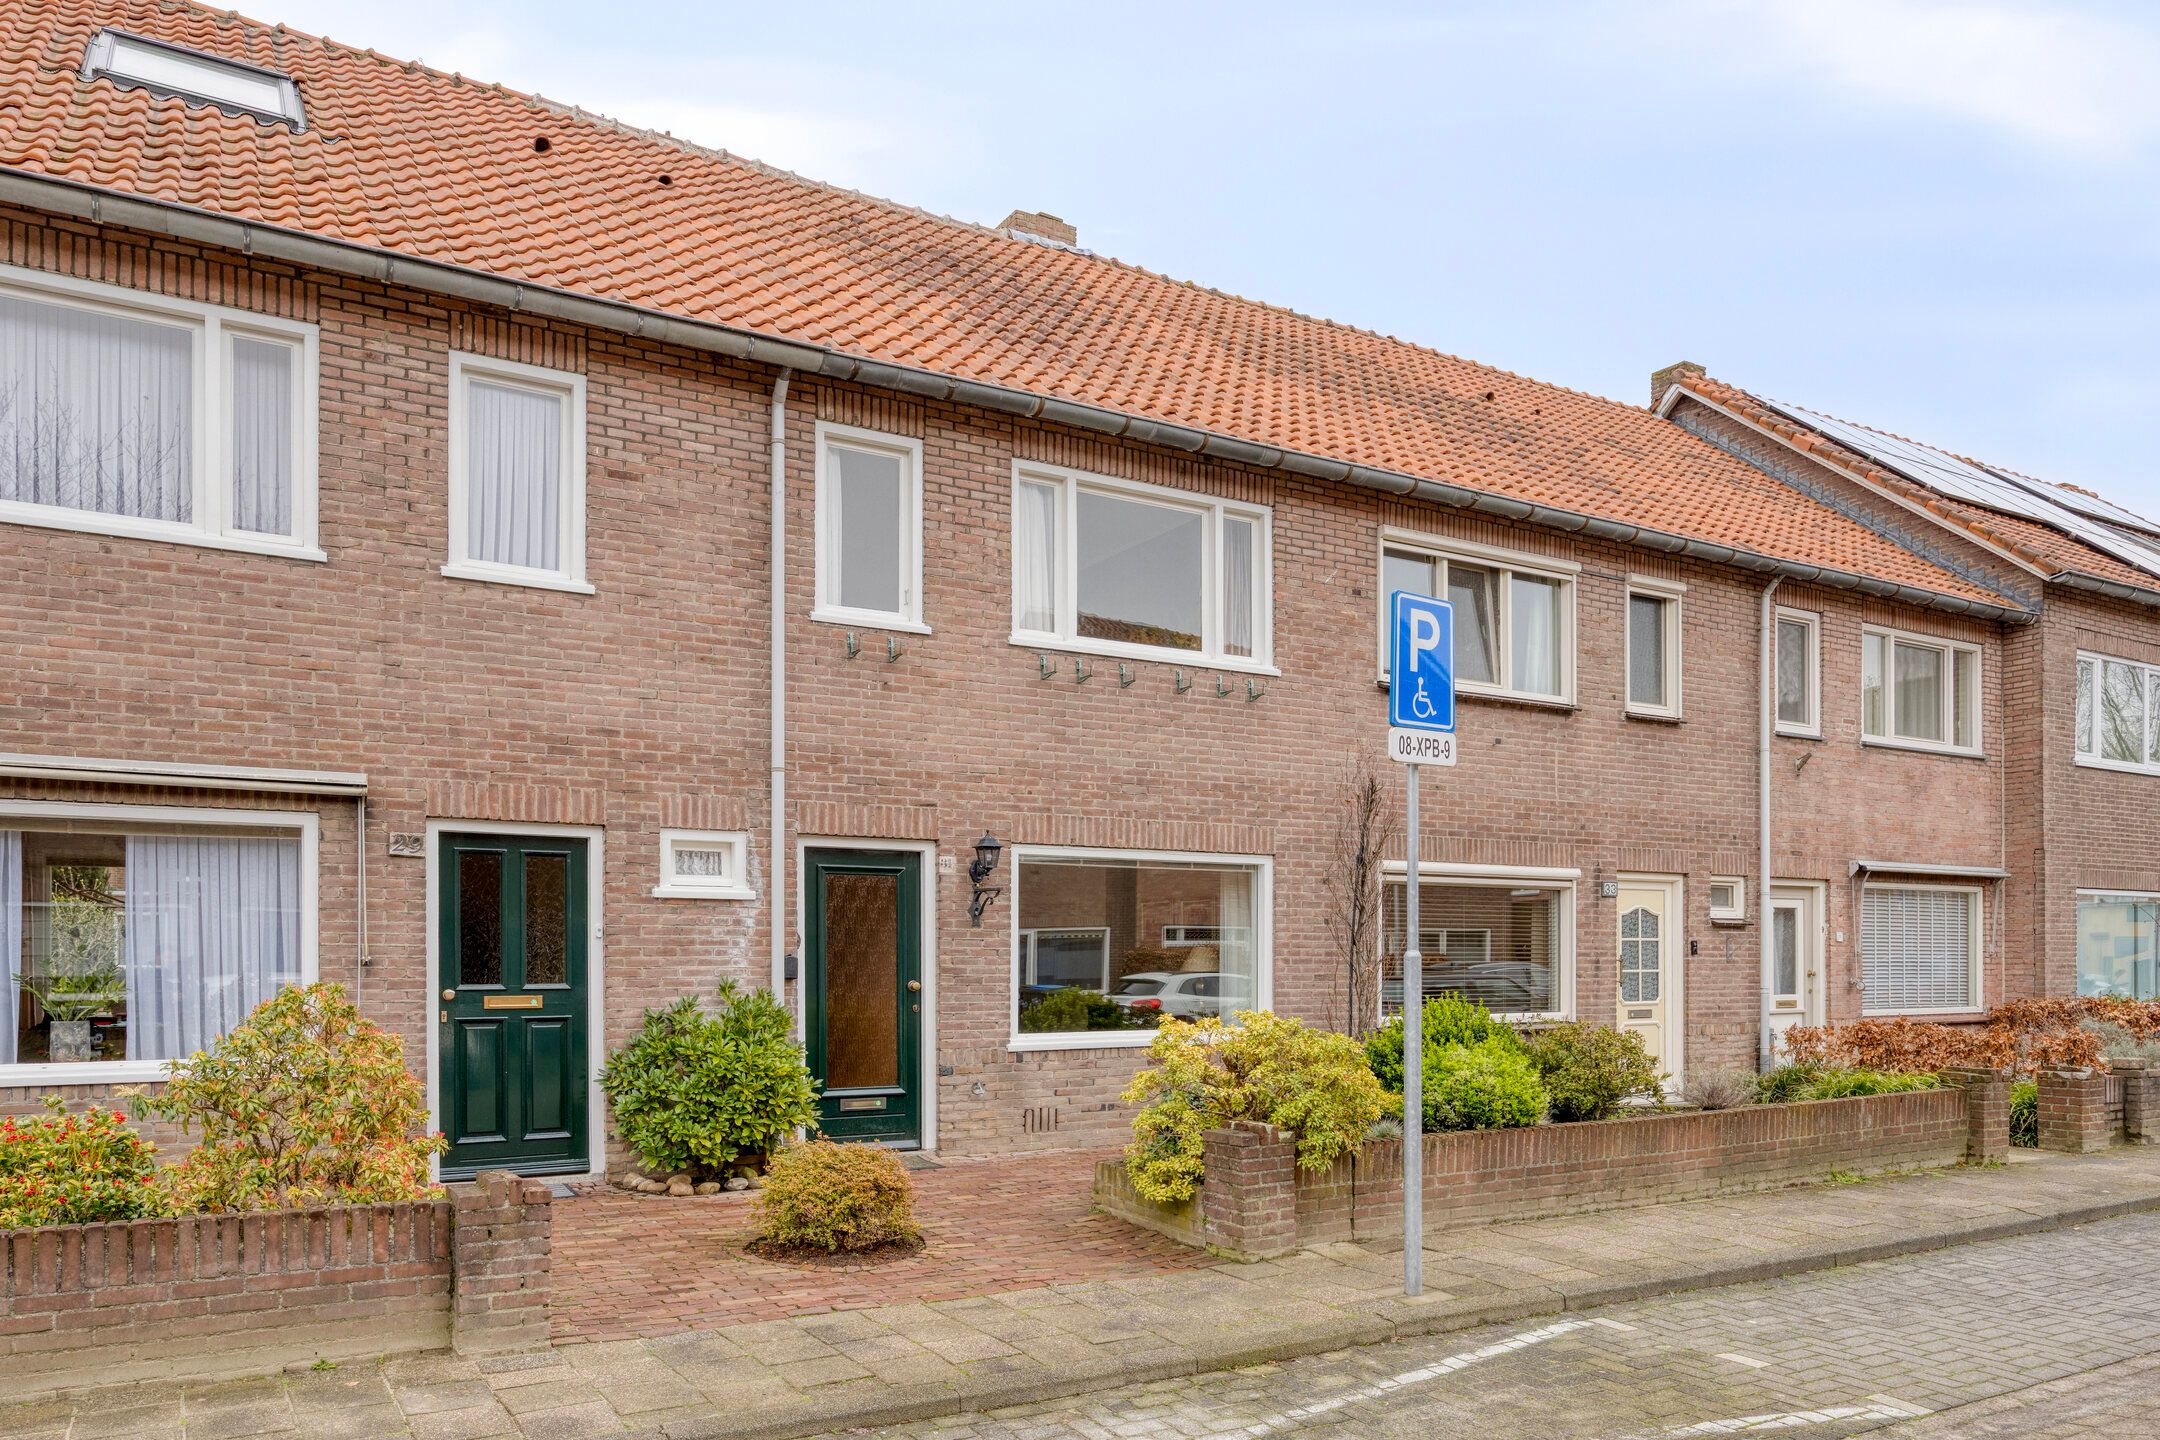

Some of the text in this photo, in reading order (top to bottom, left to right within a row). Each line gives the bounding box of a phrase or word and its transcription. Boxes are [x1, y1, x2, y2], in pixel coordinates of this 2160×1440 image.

[1409, 607, 1441, 673] P
[1398, 735, 1451, 759] 08-XPB-9
[391, 833, 424, 854] 29
